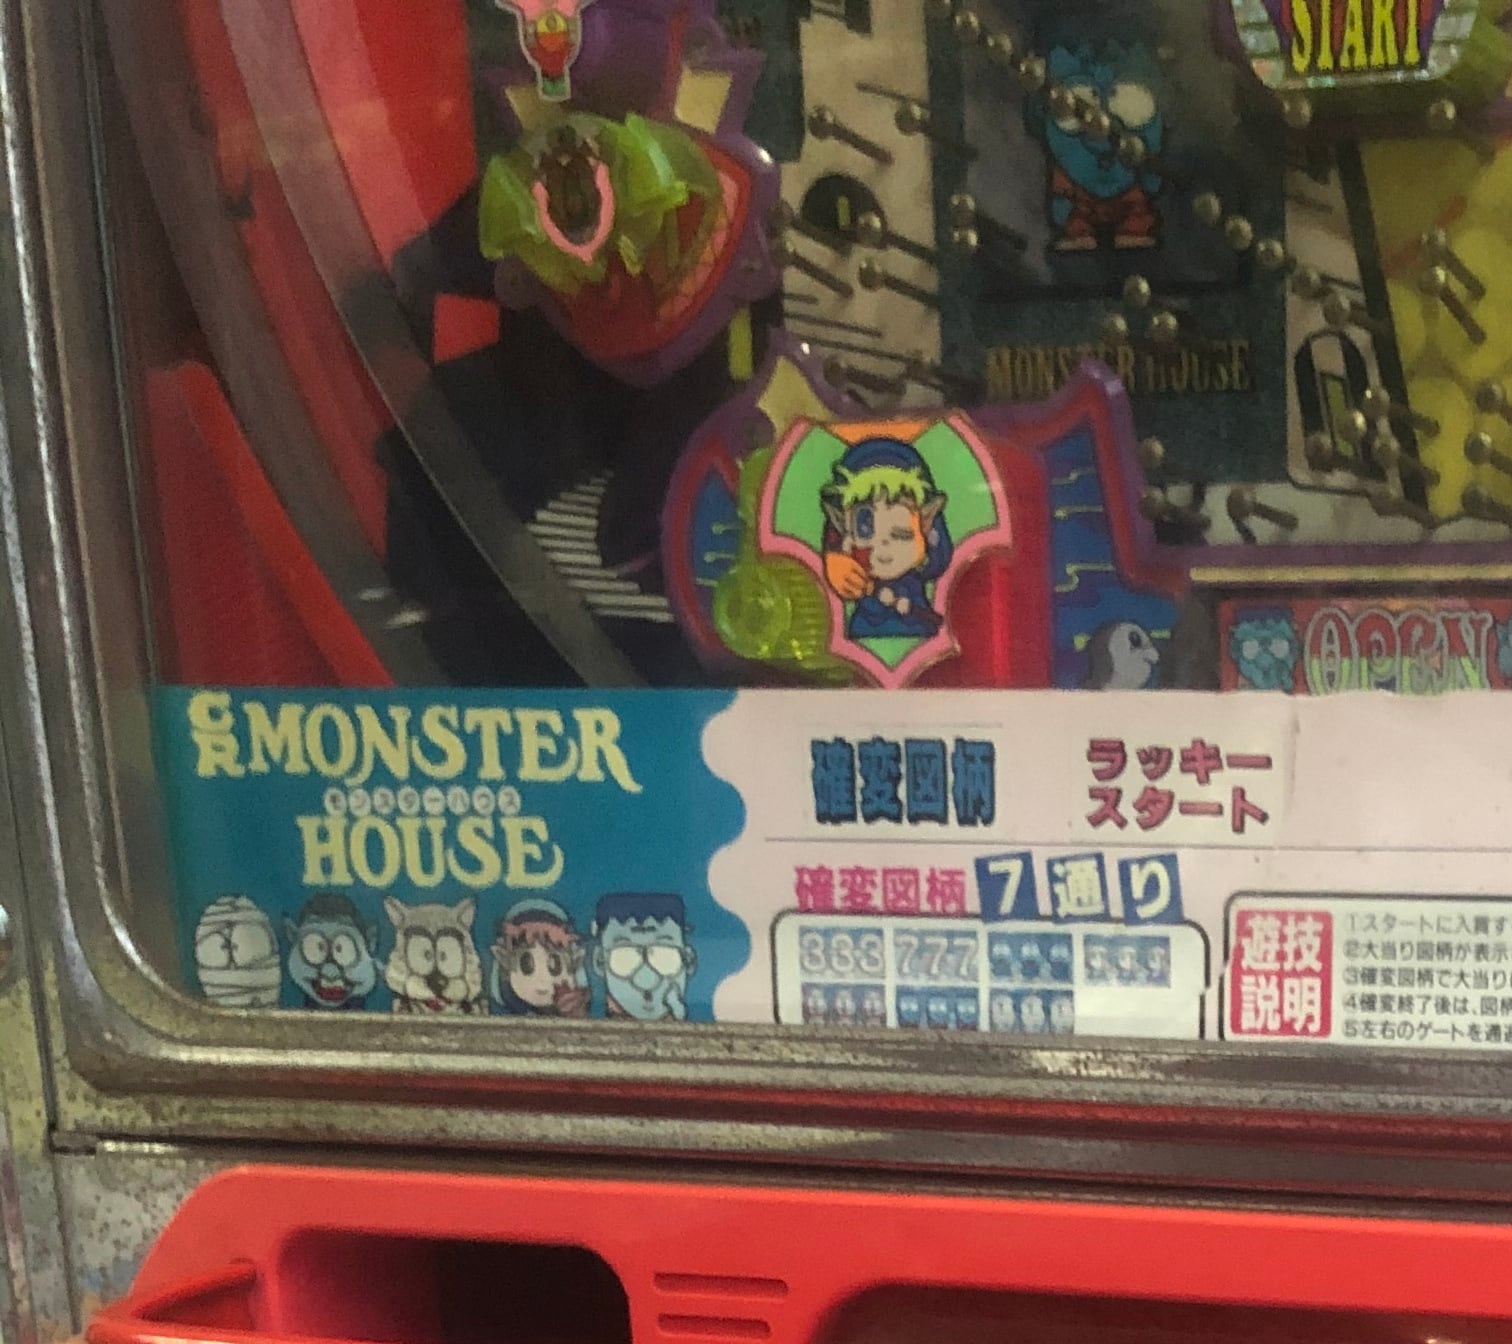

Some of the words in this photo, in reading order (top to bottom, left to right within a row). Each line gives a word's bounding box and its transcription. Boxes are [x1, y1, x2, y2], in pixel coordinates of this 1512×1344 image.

[1291, 0, 1420, 72] START
[243, 702, 643, 793] MONSTER
[1085, 737, 1273, 784] ラッキー
[810, 736, 996, 827] 確変図柄
[1085, 784, 1270, 835] スタート
[297, 815, 565, 888] HOUSE
[793, 864, 968, 915] 確変図柄
[895, 931, 979, 975] 777
[1241, 914, 1323, 972] 遊技
[1241, 974, 1322, 1033] 説明
